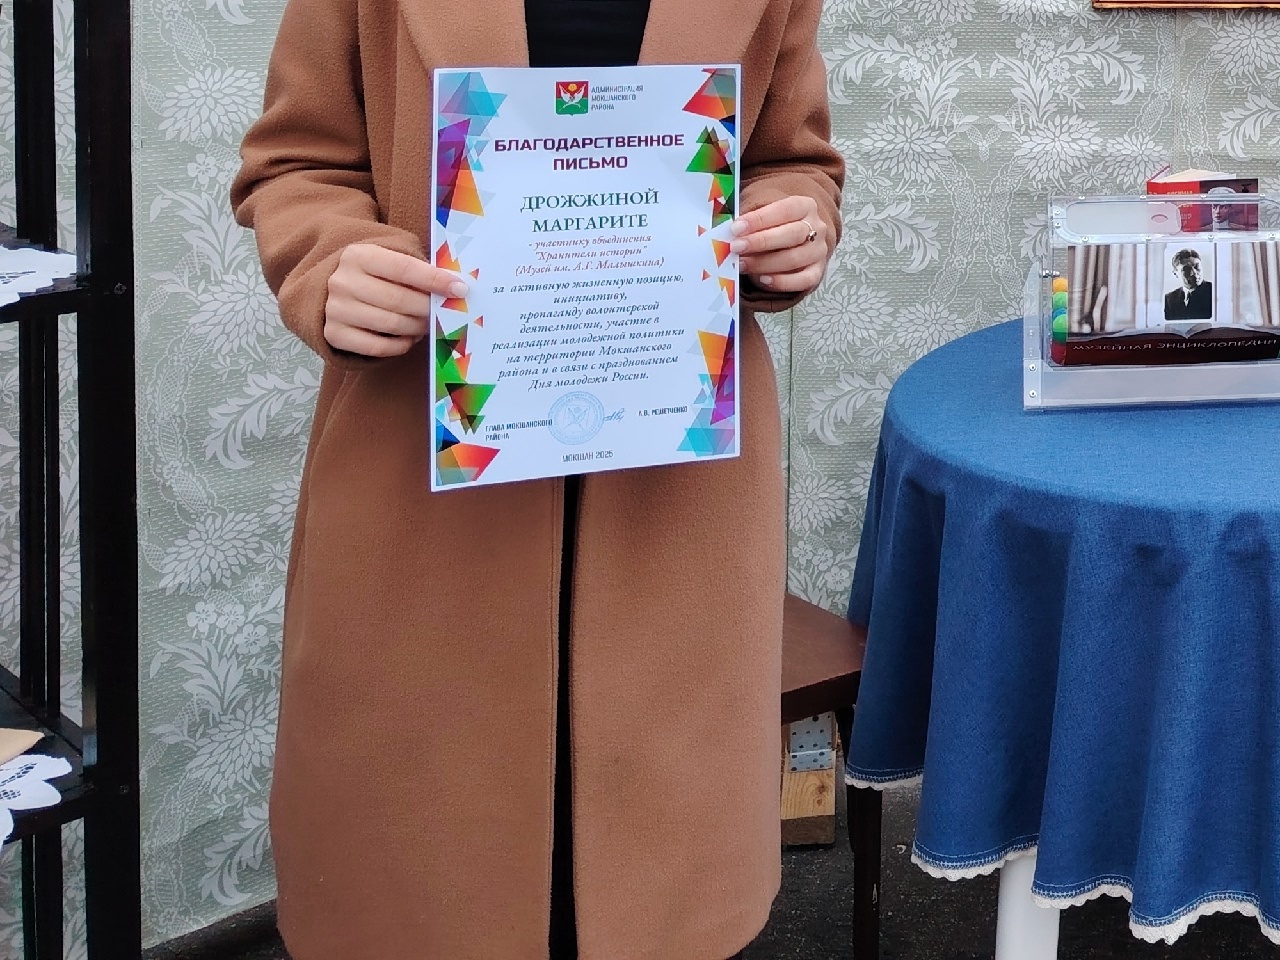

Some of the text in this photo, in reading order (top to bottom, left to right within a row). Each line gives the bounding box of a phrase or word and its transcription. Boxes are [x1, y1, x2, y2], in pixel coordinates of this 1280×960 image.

[494, 134, 685, 152] БЛАГОДАРСТВЕННОЕ
[553, 156, 628, 171] ПИСЬМО
[520, 187, 660, 214] ДРОЖЖИНОЙ
[532, 214, 648, 233] МАРГАРИТЕ
[534, 238, 590, 251] участнику
[493, 286, 504, 294] за
[510, 282, 570, 293] активную
[572, 278, 634, 290] жизненную
[520, 301, 660, 322] пропаганду волонтерской
[604, 317, 652, 330] участие
[491, 328, 685, 353] реализации молодежной политики
[506, 343, 672, 364] на территории Мокшанского
[498, 367, 539, 382] района
[560, 362, 588, 372] связи
[599, 355, 679, 374] празднованием
[528, 378, 552, 392] Дня
[554, 374, 608, 388] молодежи
[596, 449, 614, 460] 2025
